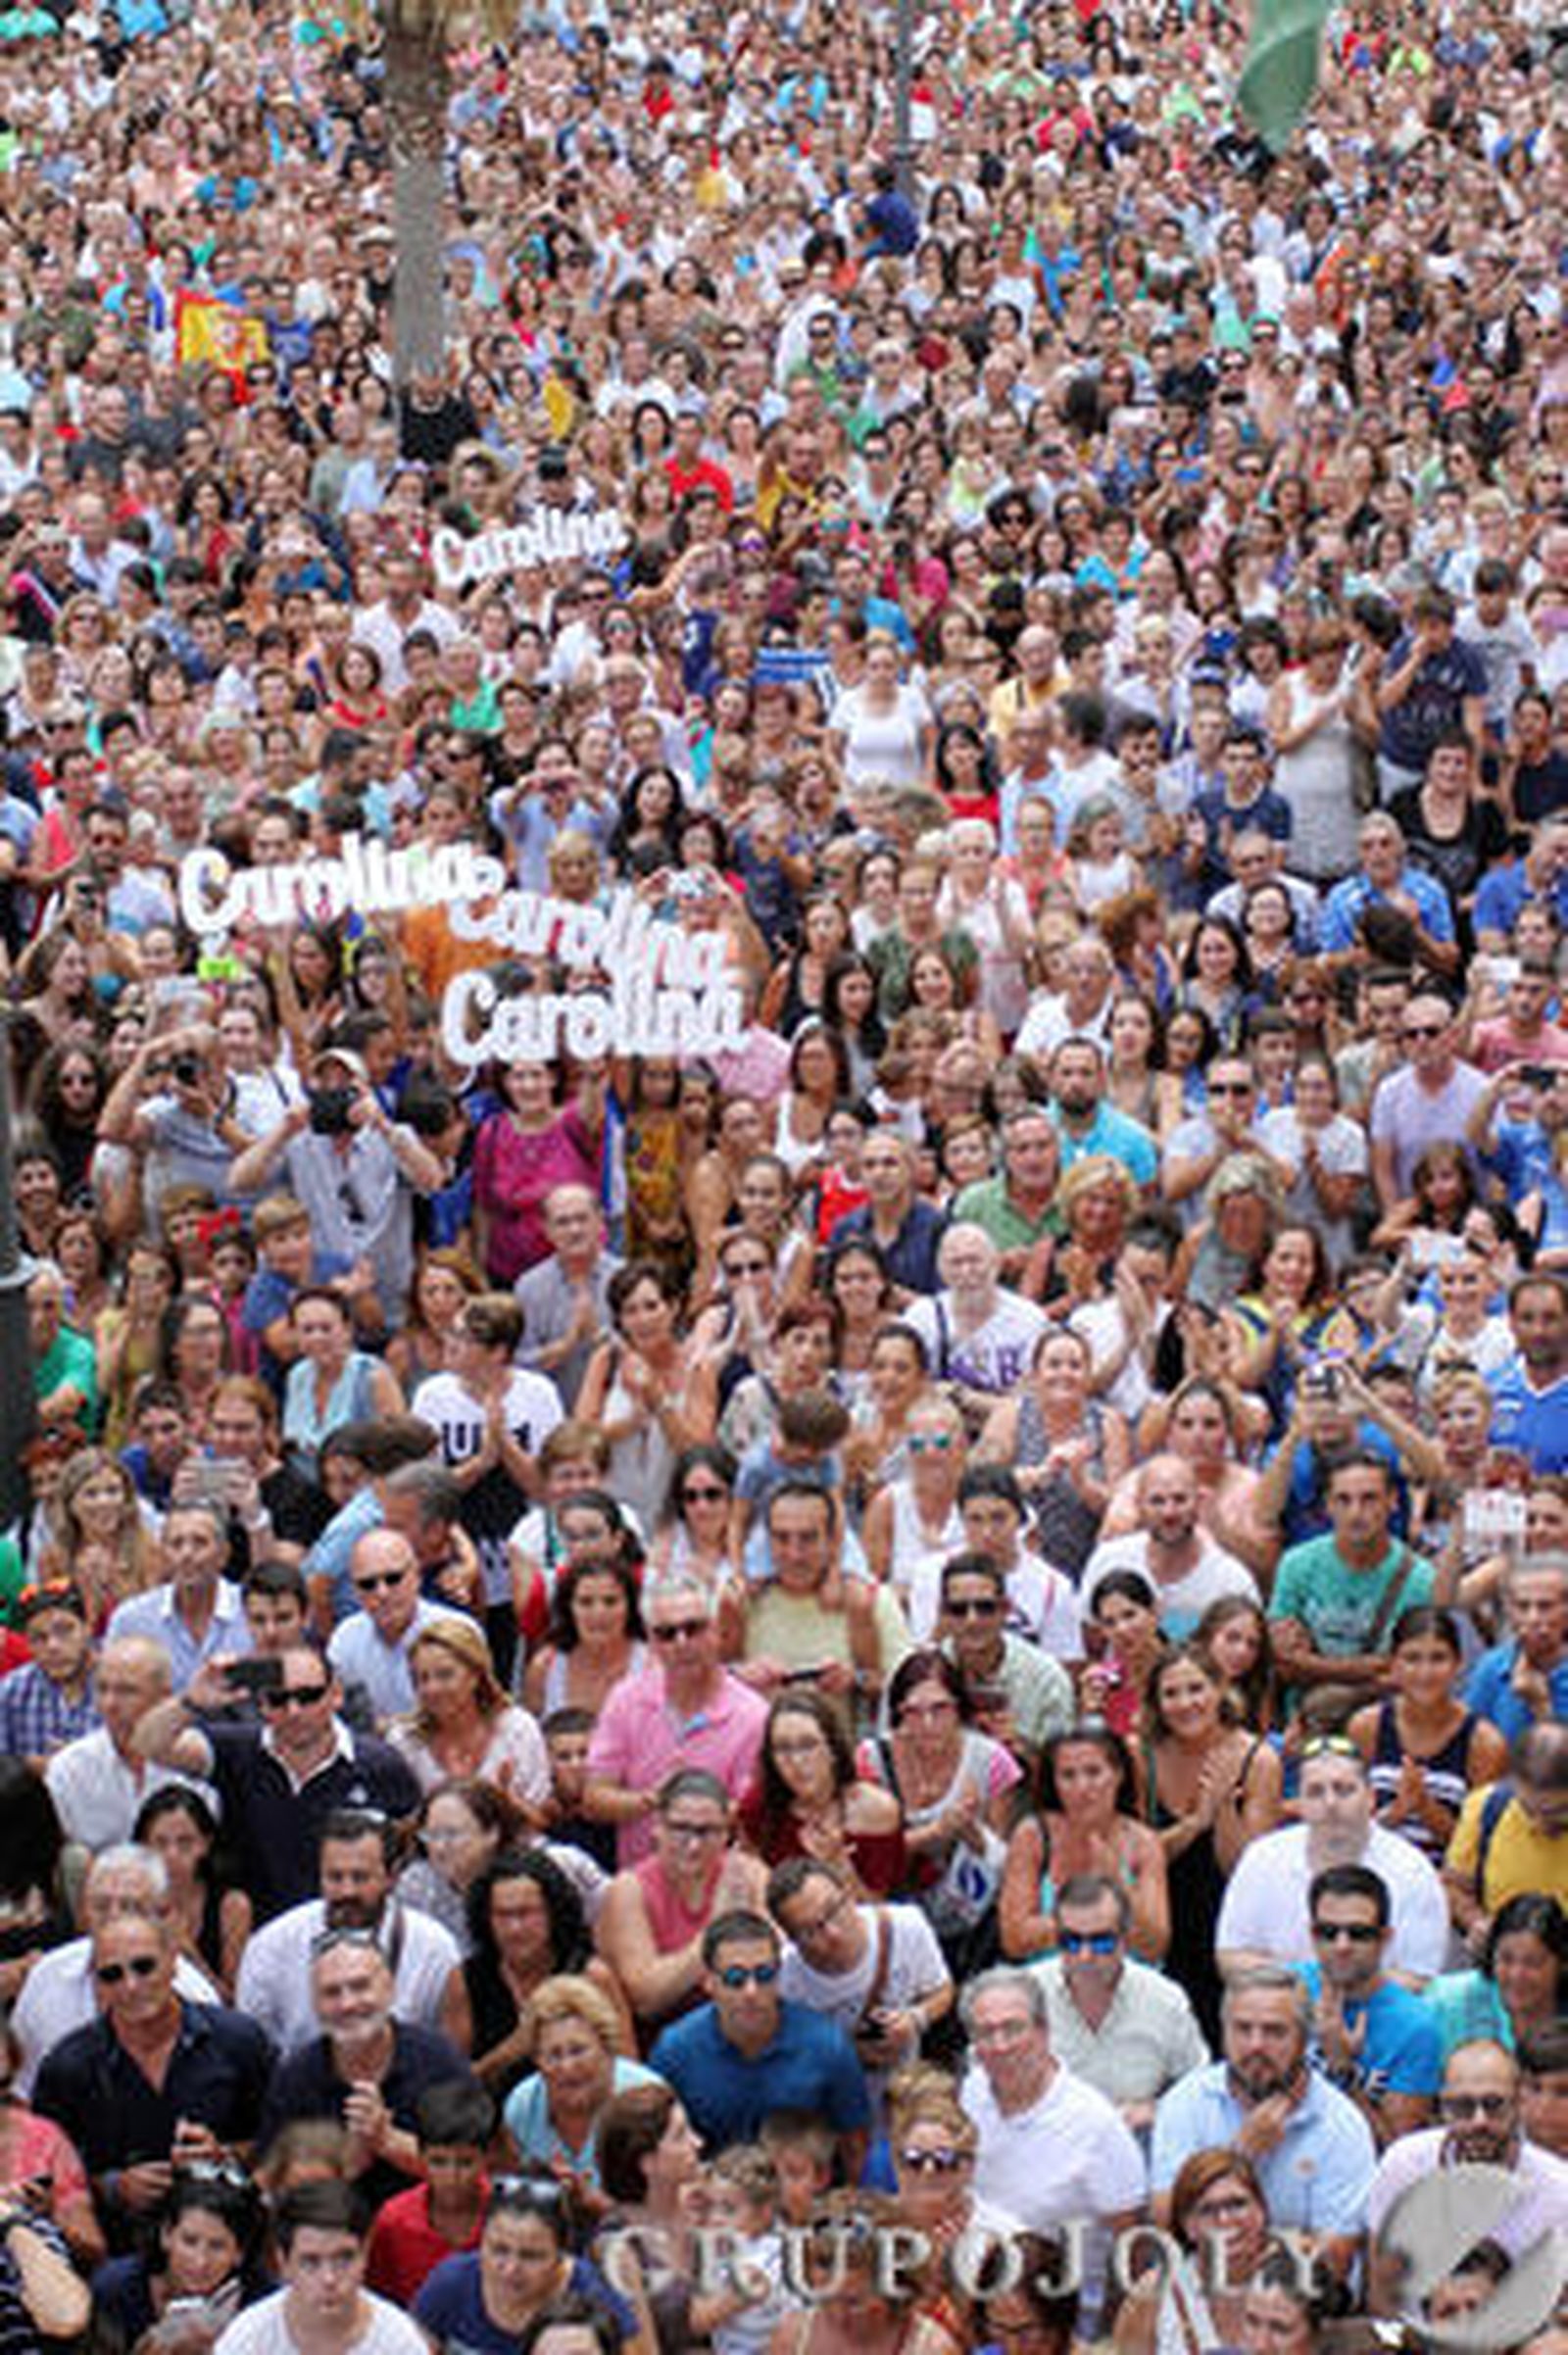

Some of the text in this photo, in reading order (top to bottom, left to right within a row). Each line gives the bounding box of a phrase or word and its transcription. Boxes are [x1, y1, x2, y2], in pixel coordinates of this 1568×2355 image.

[431, 504, 628, 588] Carolina
[179, 830, 476, 934] Carolina
[448, 856, 745, 990] Carolina
[442, 966, 752, 1067] Carolina
